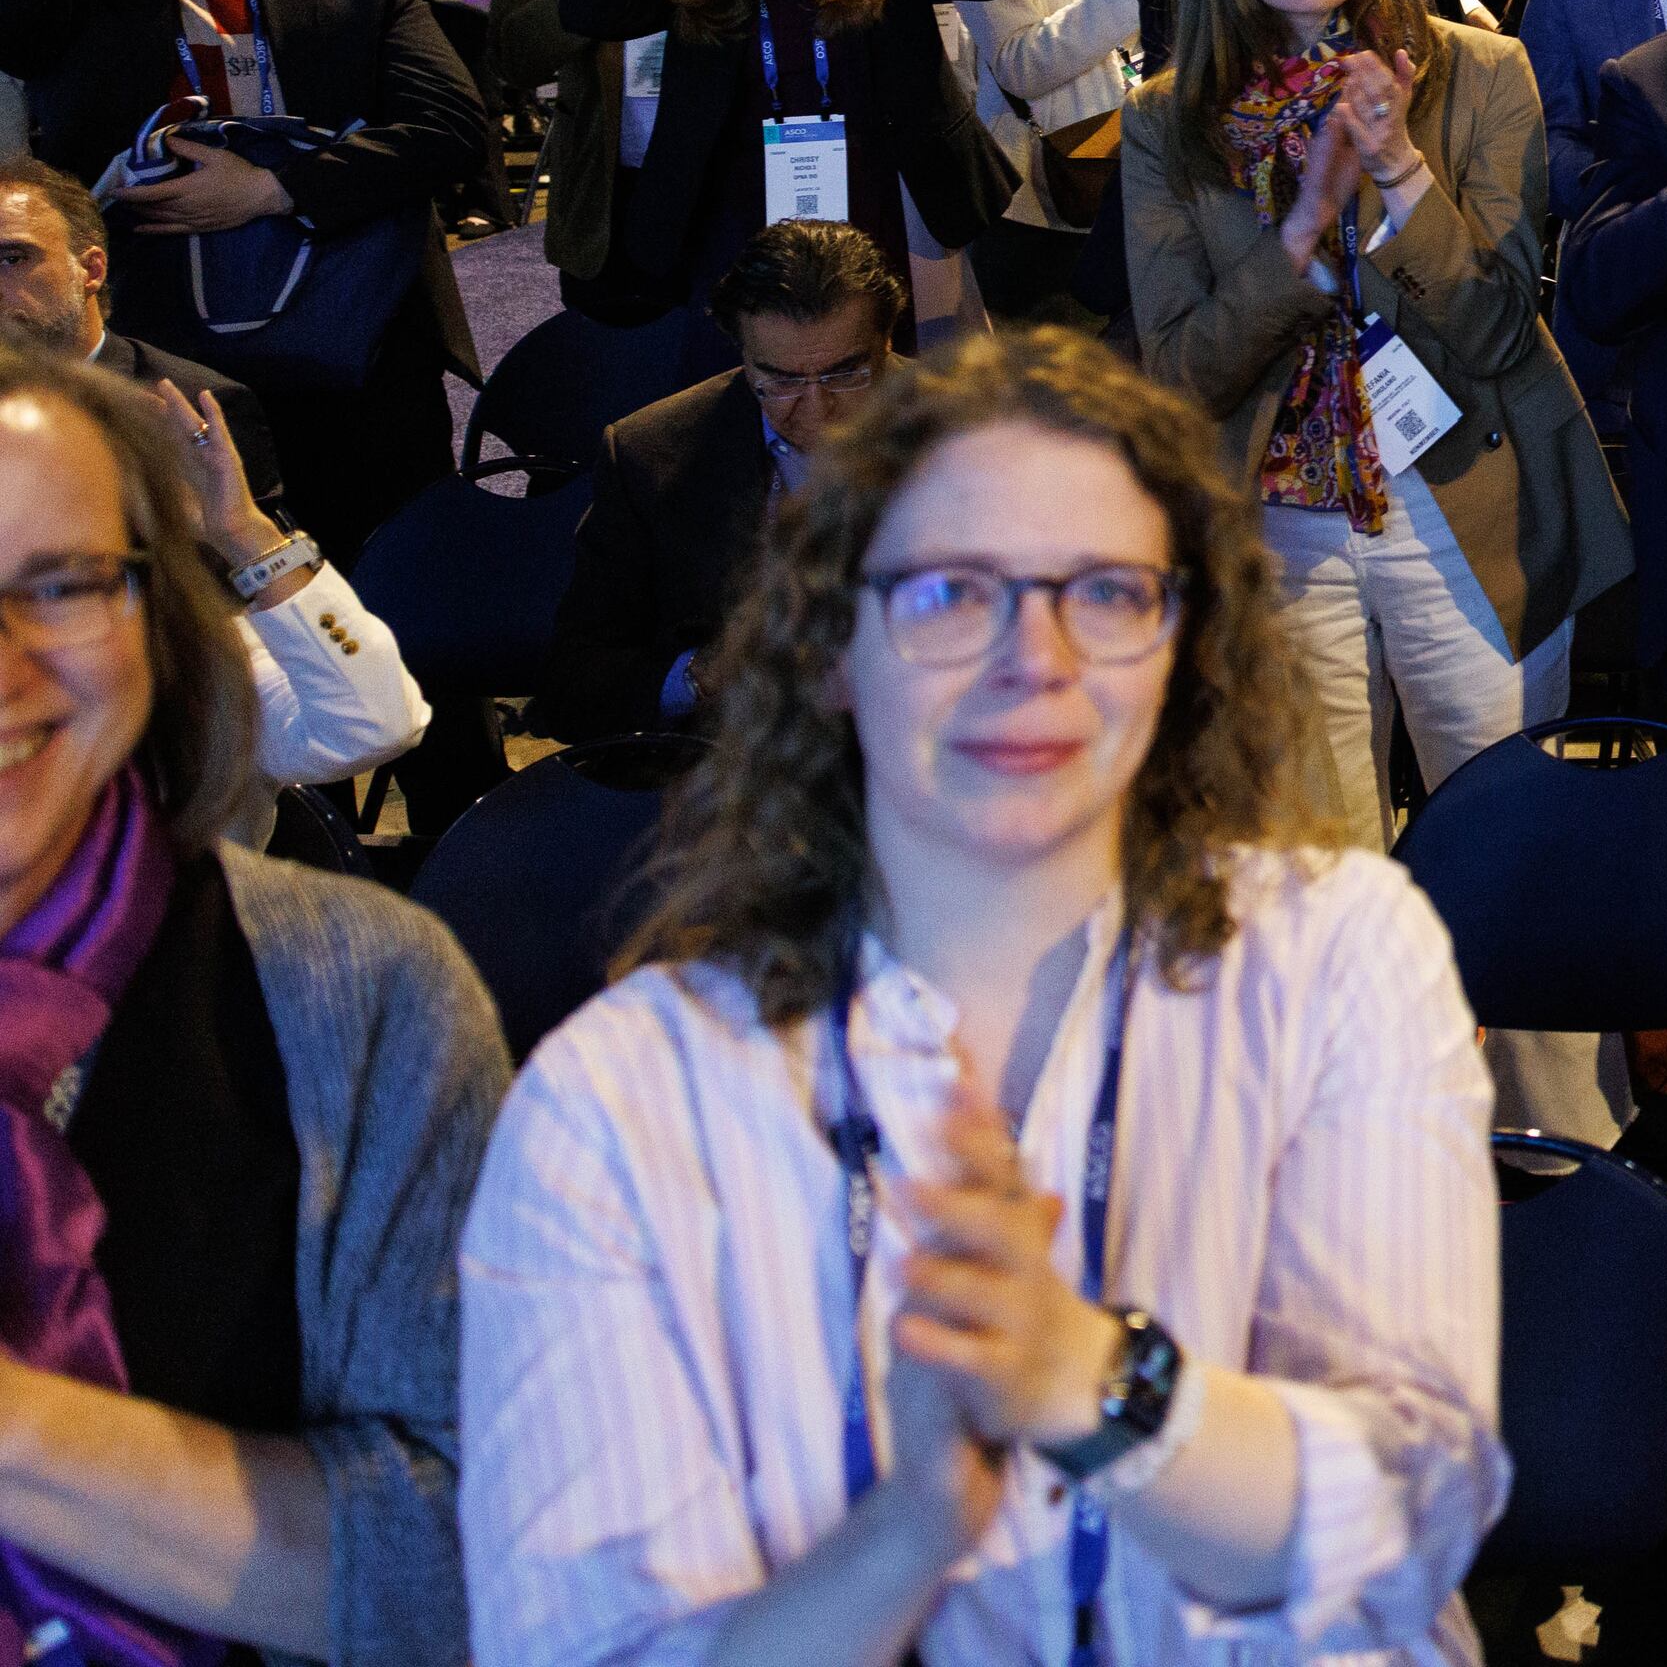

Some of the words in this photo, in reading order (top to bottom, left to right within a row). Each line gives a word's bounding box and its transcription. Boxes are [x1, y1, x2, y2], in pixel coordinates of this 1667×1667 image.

[175, 38, 193, 61] ASCO
[255, 38, 266, 63] ASCO
[763, 41, 774, 65] ASCO
[815, 38, 825, 59] SCO
[1345, 226, 1356, 253] ASCO
[1365, 368, 1390, 392] TEFANIA
